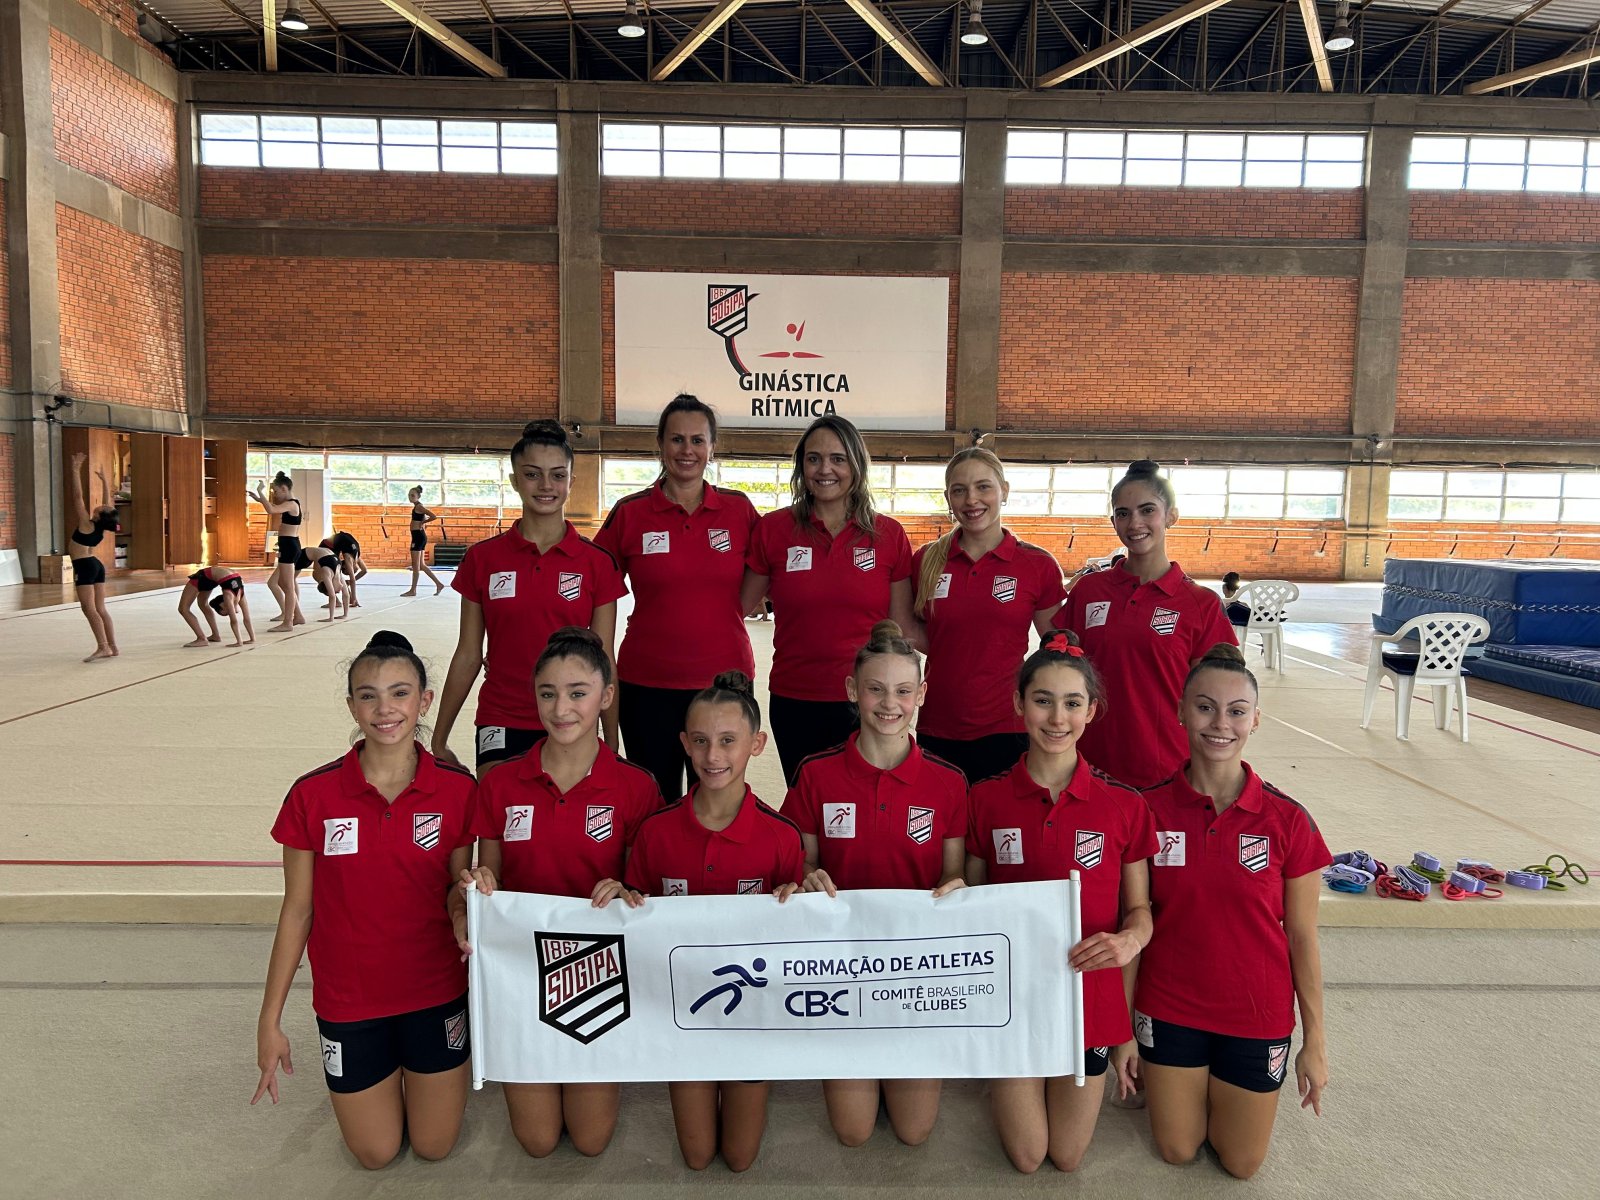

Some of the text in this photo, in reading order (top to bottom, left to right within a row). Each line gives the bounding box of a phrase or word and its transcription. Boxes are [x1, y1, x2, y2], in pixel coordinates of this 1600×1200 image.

[710, 288, 728, 301] 1867
[711, 291, 745, 324] SOGIPA
[738, 369, 850, 393] GINÁSTICA
[751, 394, 837, 418] RÍTMICA
[416, 817, 440, 840] SOGIPA
[588, 810, 612, 833] SOGIPA
[1077, 836, 1101, 858] SOGIPA
[1241, 841, 1266, 862] SOGIPA
[543, 939, 579, 964] 1867
[783, 950, 995, 979] FORMAÇÃO DE ATLETAS
[547, 946, 620, 1011] SOGIPA
[784, 989, 849, 1017] CBC
[871, 983, 995, 1001] COMITÊ BRASILEIRO
[914, 998, 967, 1012] CLUBES
